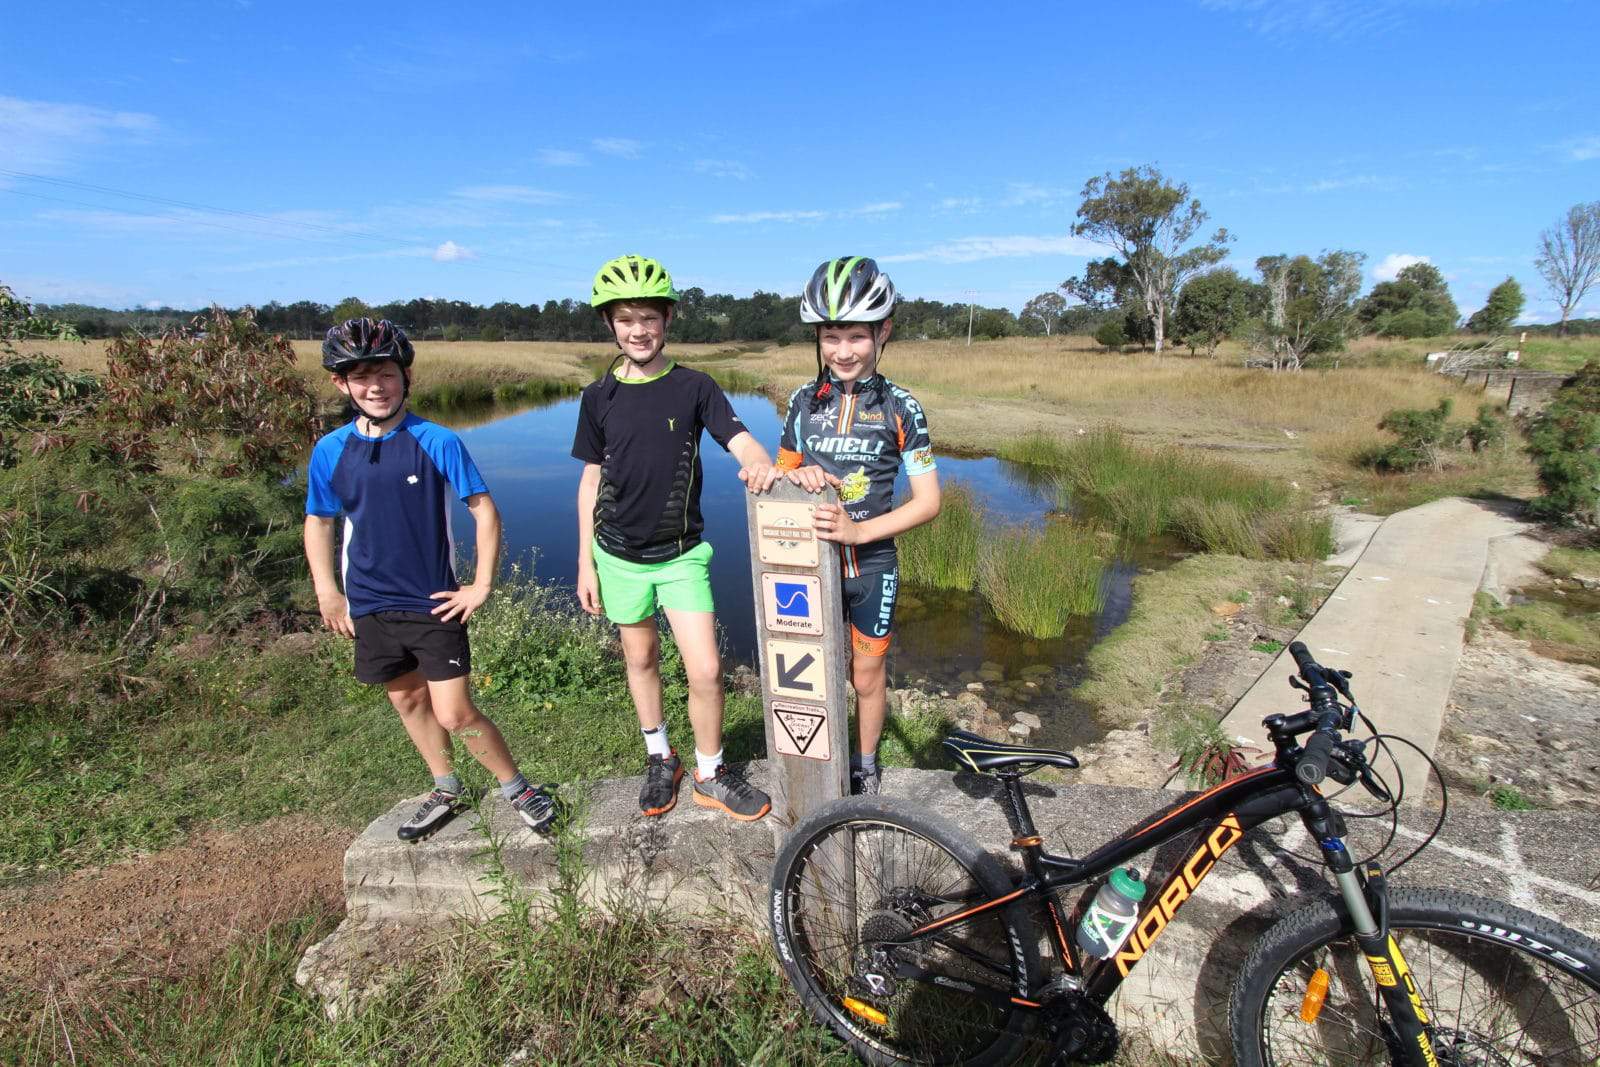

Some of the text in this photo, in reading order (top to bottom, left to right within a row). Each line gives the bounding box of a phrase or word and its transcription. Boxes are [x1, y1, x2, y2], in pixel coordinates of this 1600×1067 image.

[834, 454, 879, 462] RACING
[776, 618, 812, 628] Moderate
[1115, 812, 1244, 978] NORCO
